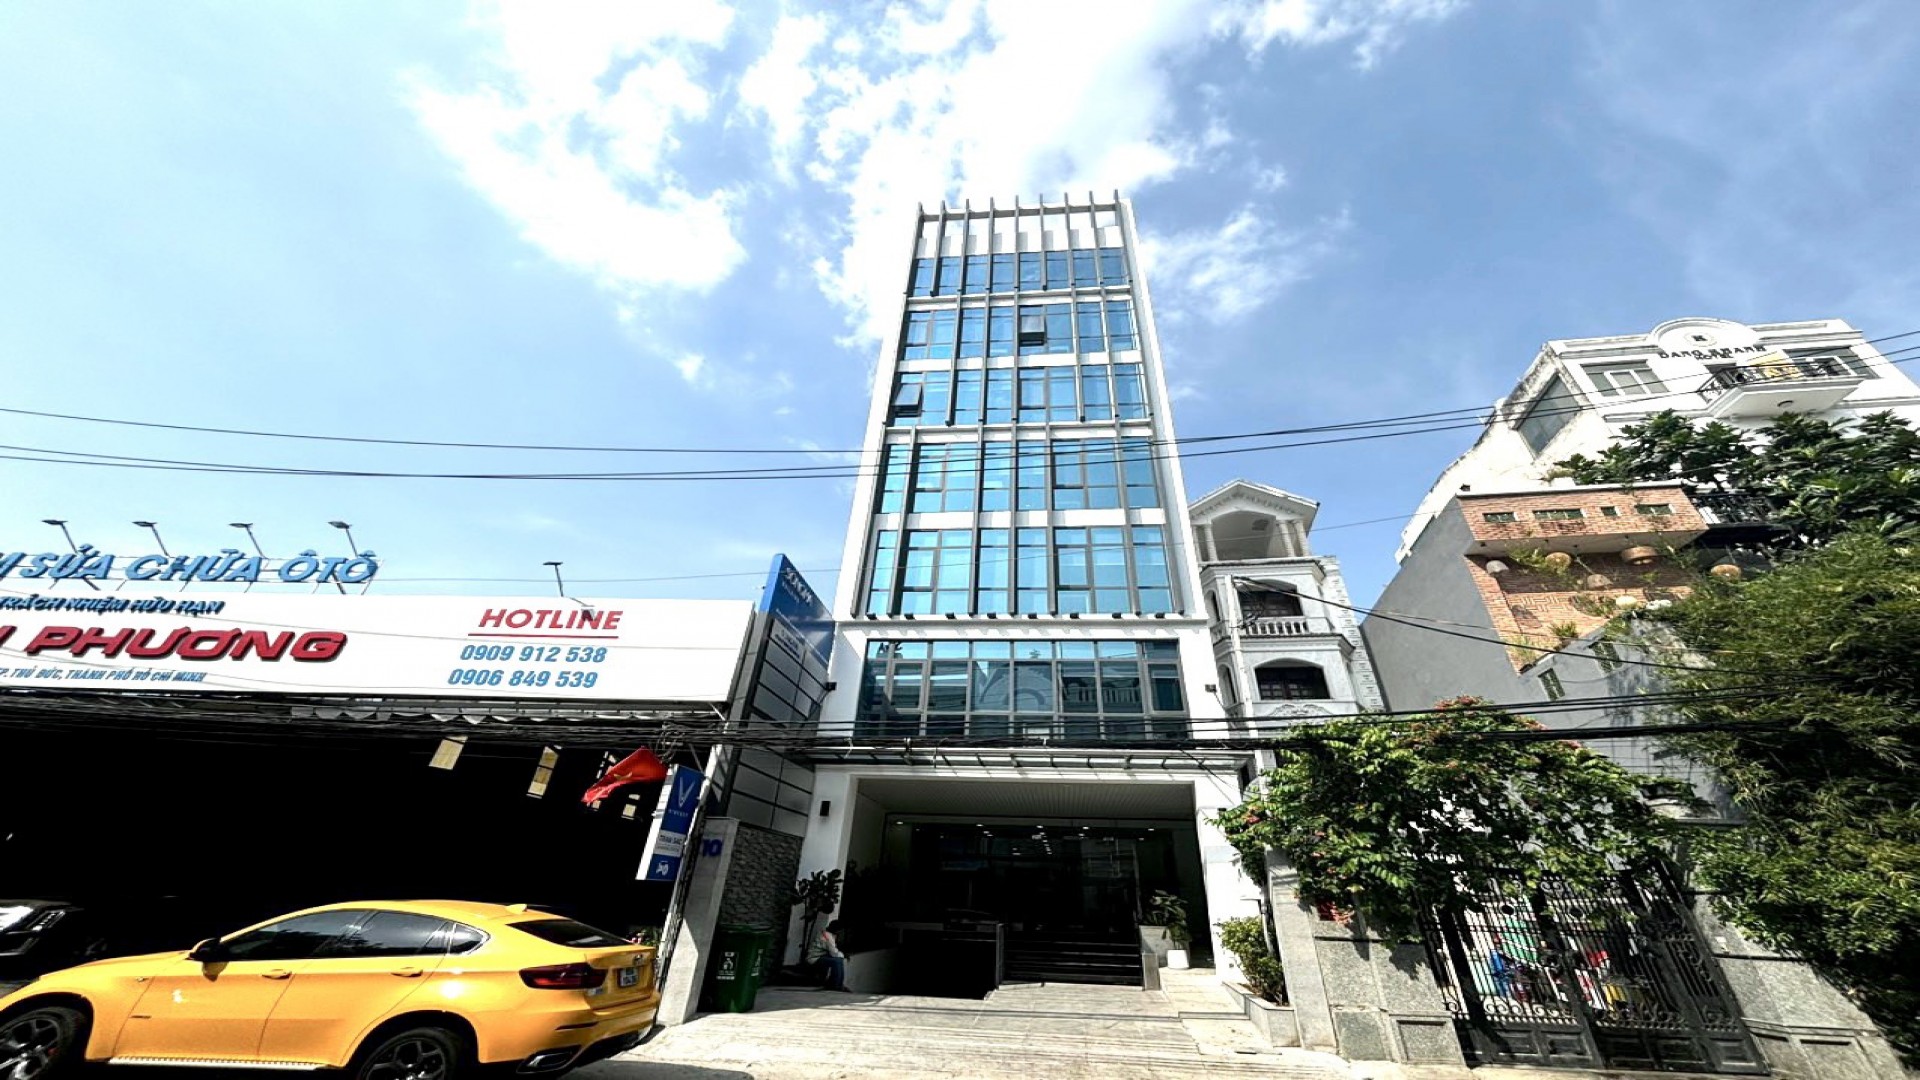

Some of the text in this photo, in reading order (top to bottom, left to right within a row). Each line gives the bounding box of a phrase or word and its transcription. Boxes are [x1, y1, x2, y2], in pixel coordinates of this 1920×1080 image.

[478, 608, 623, 630] HOTLINE
[24, 626, 348, 661] PHƯƠNG
[460, 645, 608, 663] 0909 912 538
[448, 669, 598, 688] 0906 849 539
